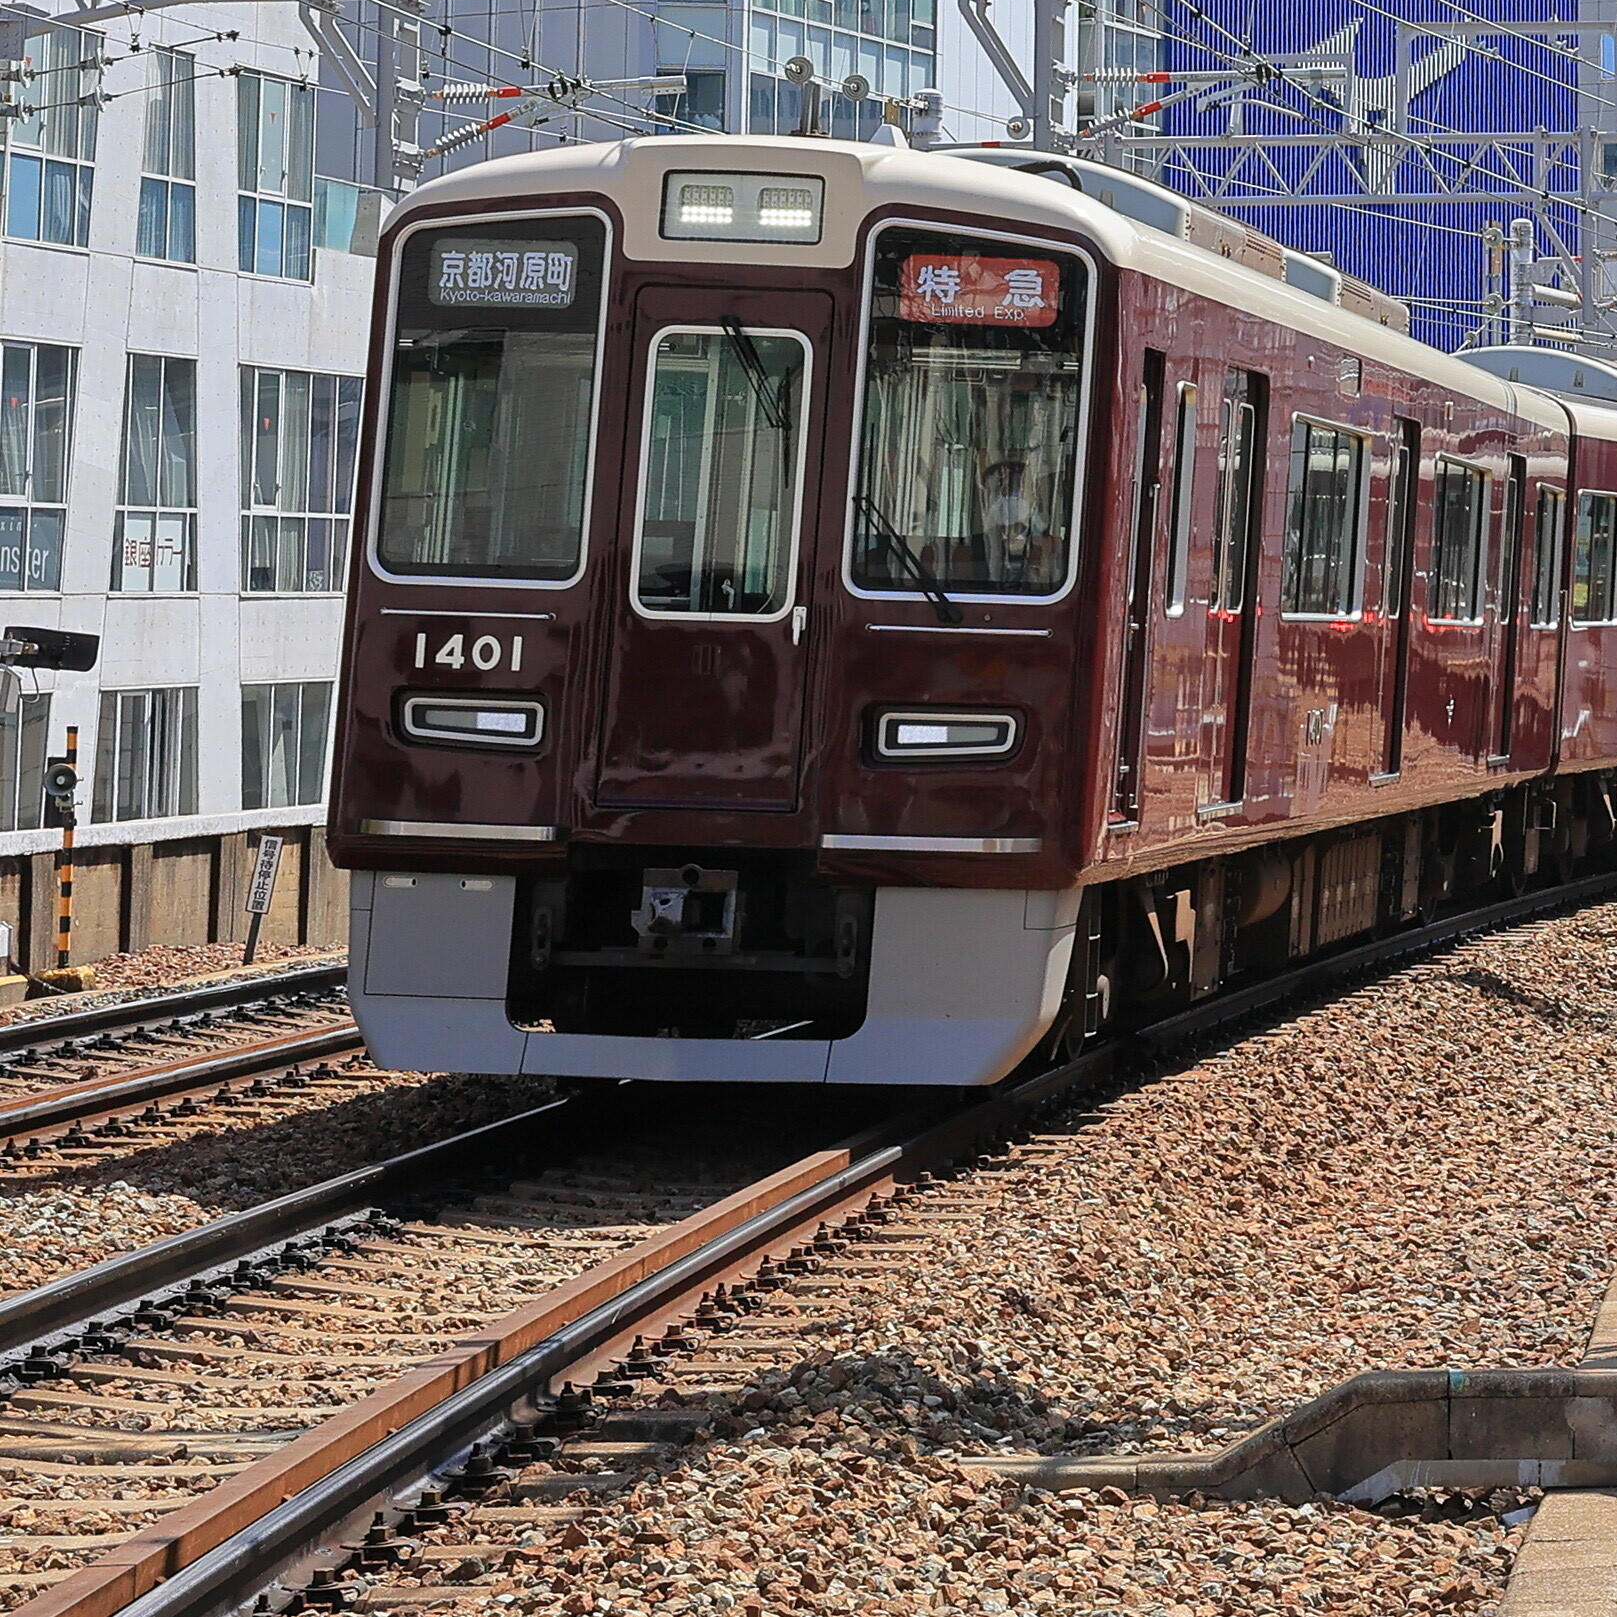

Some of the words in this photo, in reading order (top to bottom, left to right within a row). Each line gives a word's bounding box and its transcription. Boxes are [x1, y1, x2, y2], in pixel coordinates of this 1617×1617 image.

[439, 251, 574, 291] 京都河原町
[917, 265, 1045, 308] 特急
[440, 288, 571, 305] Kyoto-kawaramachi
[931, 304, 985, 318] Limited
[994, 306, 1027, 321] Exp.
[415, 633, 522, 672] 1401
[251, 839, 278, 911] 信号待停止位置
